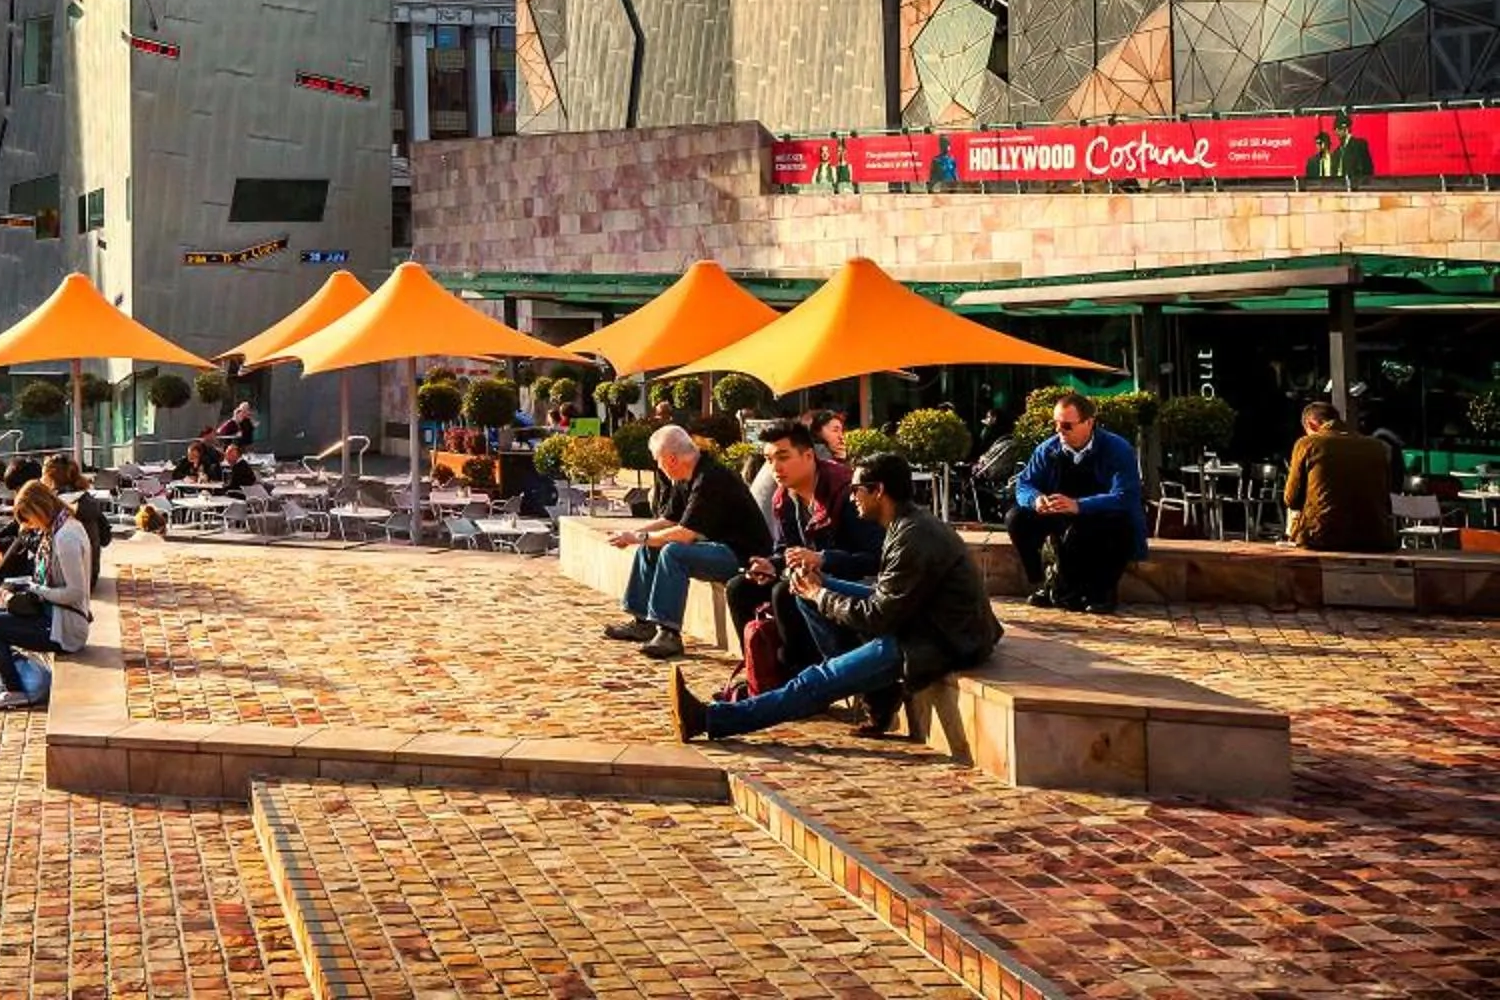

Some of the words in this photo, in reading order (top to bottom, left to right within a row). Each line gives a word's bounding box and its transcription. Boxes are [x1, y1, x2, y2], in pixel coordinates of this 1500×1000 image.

[969, 144, 1075, 171] HOLLYWOOD
[1085, 130, 1217, 174] Costume
[1228, 152, 1250, 162] Open
